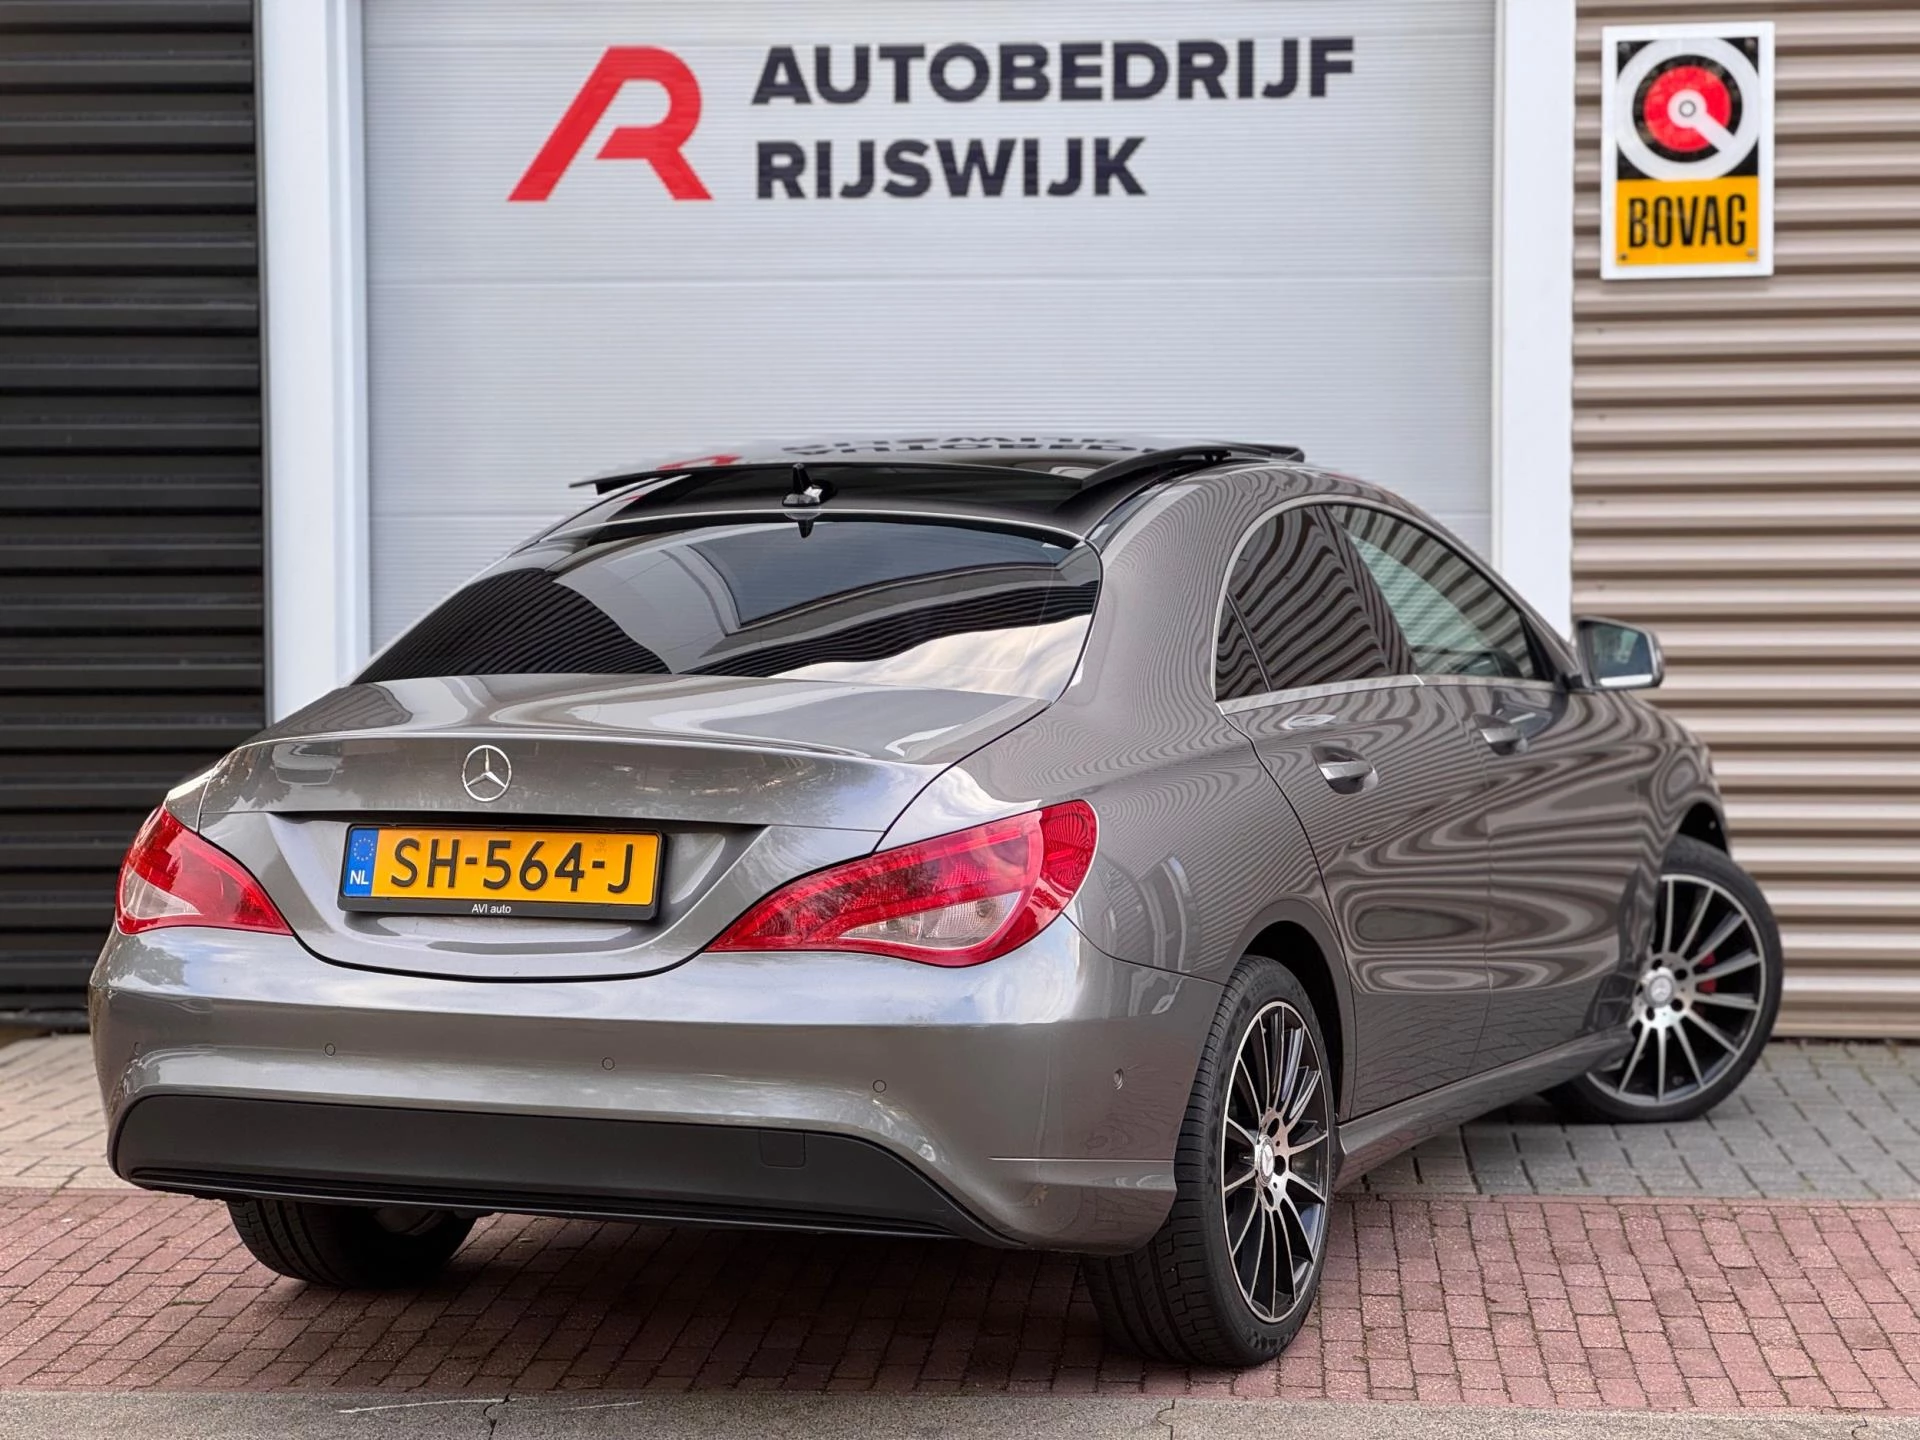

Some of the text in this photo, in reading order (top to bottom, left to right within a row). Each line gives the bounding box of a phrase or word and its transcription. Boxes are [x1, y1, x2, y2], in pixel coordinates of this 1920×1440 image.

[752, 37, 1354, 105] AUTOBEDRIJF
[757, 137, 1146, 199] RIJSWIJK
[1628, 194, 1747, 248] BOVAG
[350, 869, 370, 885] NL
[390, 838, 634, 894] SH-564-J
[471, 903, 512, 914] AVI auto
